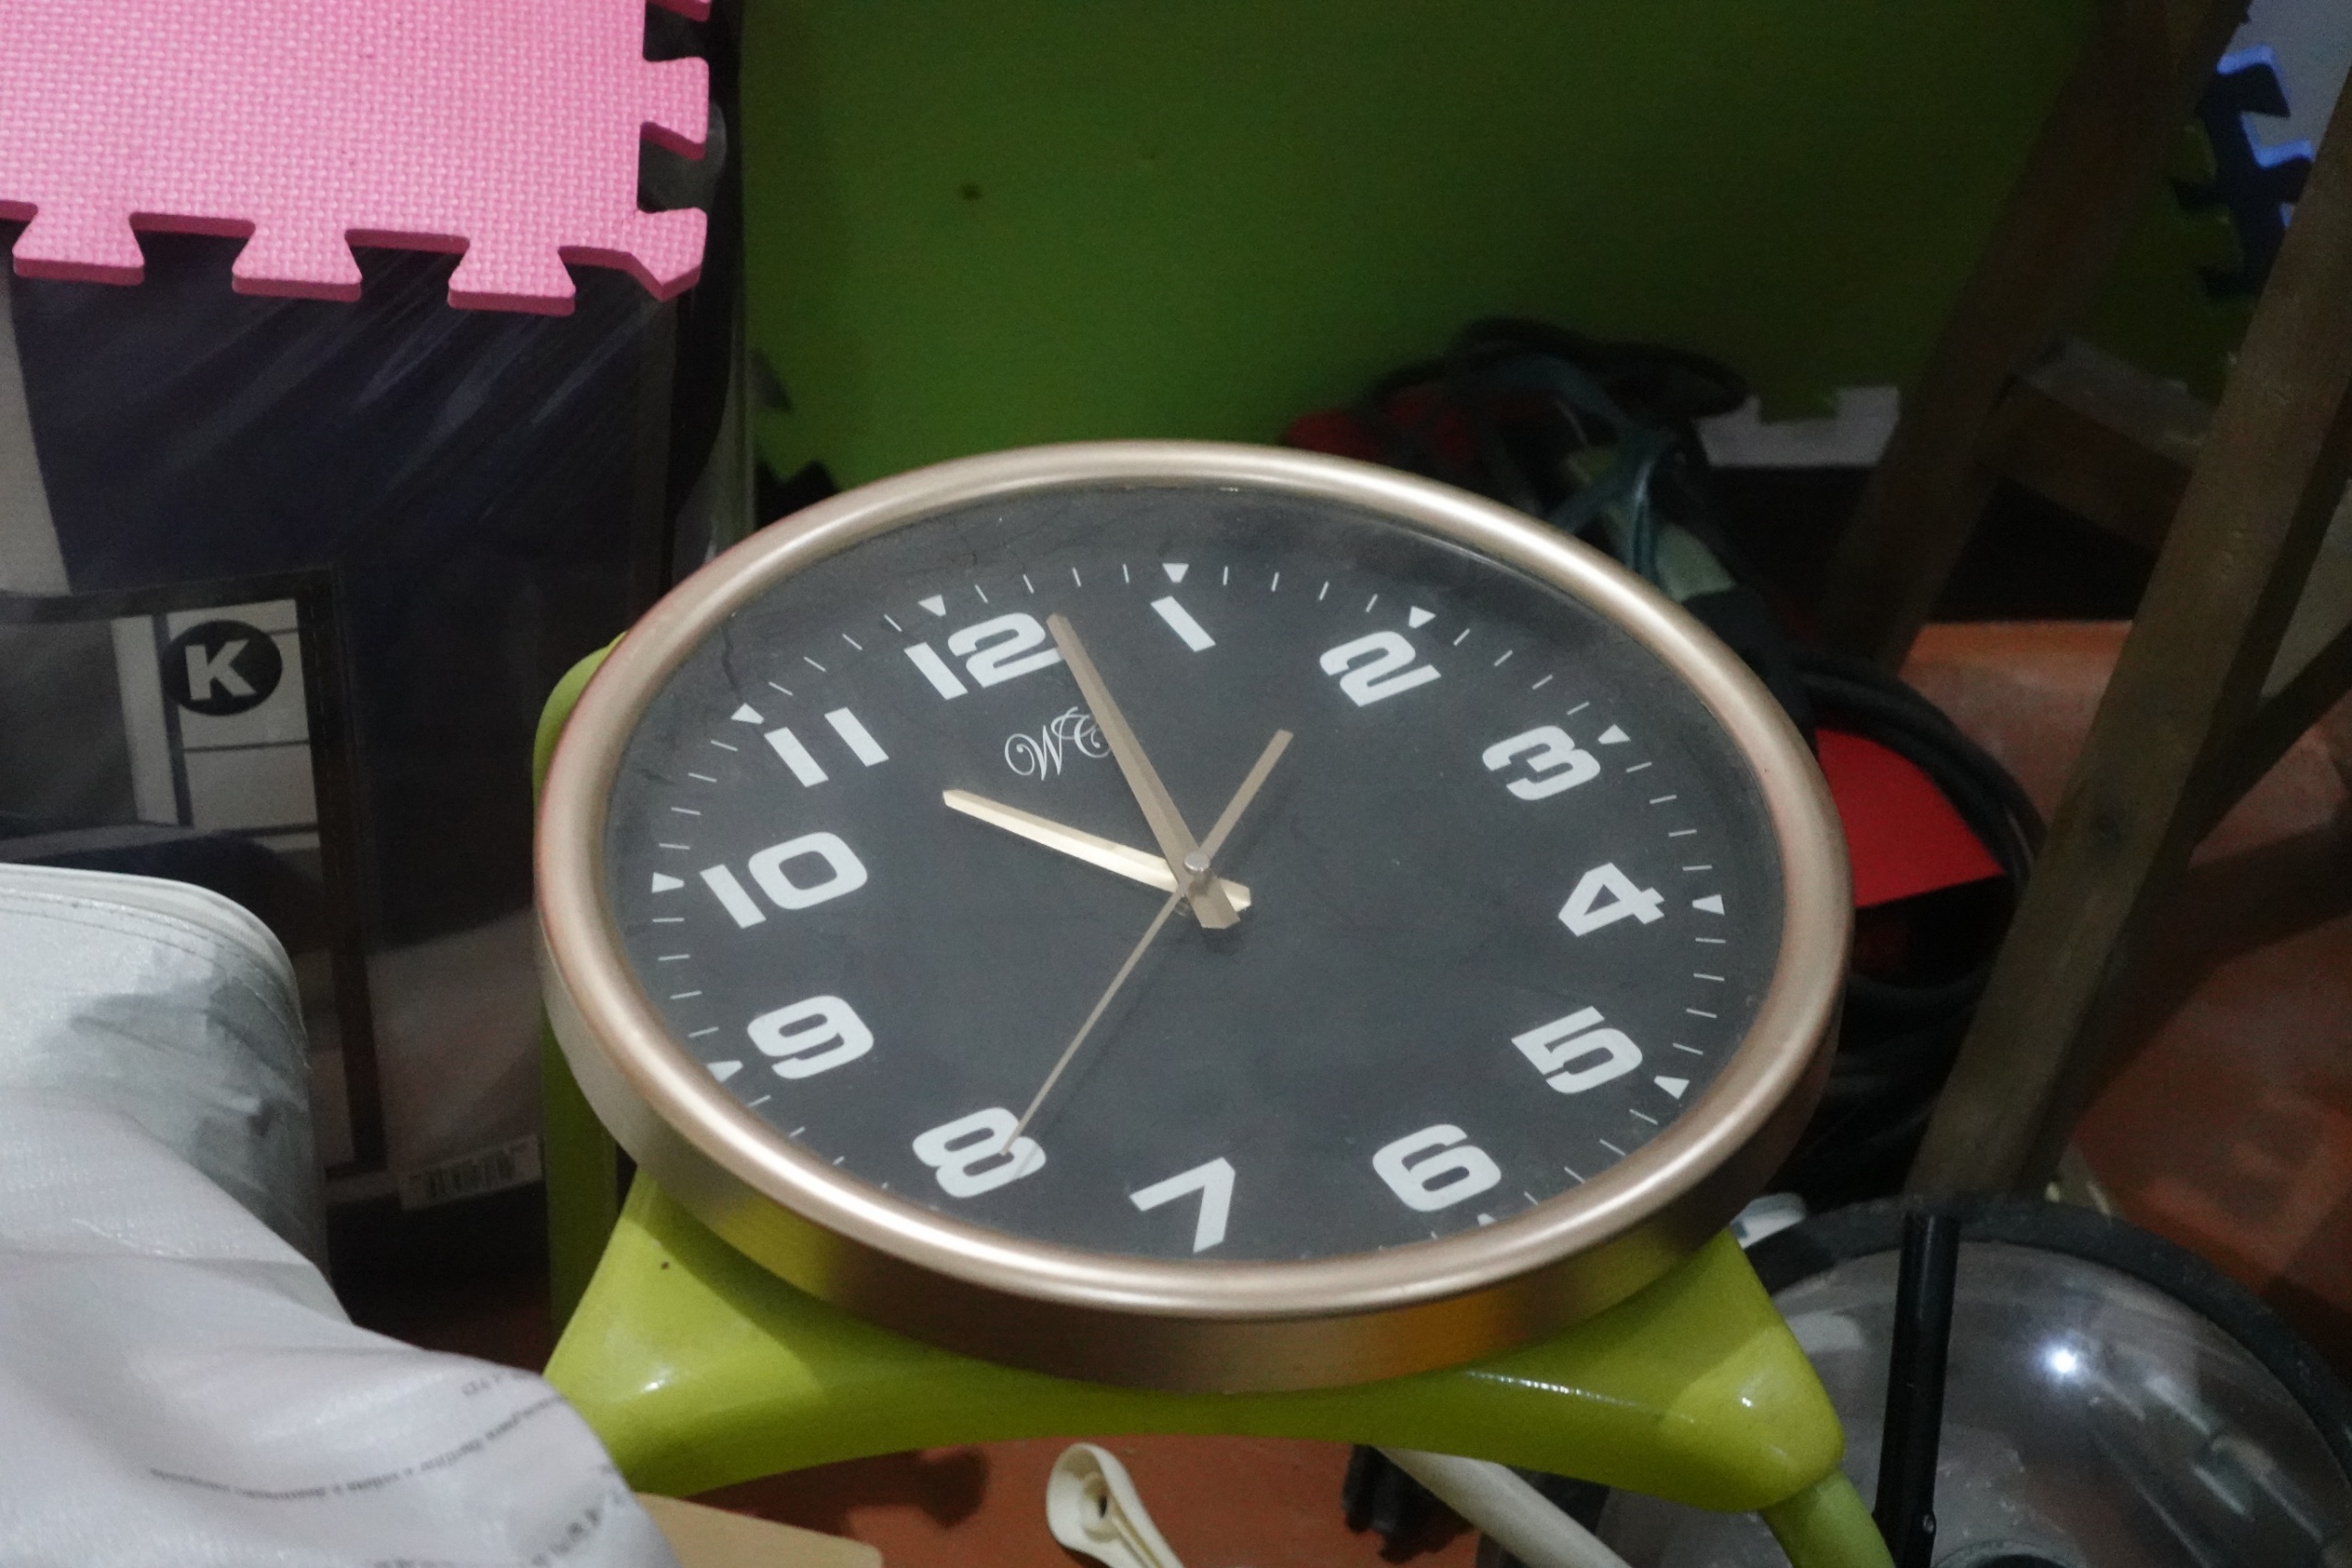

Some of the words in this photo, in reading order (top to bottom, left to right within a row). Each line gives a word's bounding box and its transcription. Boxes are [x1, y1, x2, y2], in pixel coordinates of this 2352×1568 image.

[185, 640, 256, 701] K
[904, 613, 1066, 700] 12
[1319, 631, 1442, 707] 2
[763, 707, 889, 787] 11
[1482, 725, 1600, 801] 3
[700, 832, 868, 929] 10
[1558, 862, 1665, 937] 4
[747, 995, 875, 1079] 9
[1511, 1006, 1643, 1094] 5
[912, 1107, 1046, 1198] 8
[1372, 1123, 1501, 1212] 6
[1129, 1157, 1236, 1253] 7
